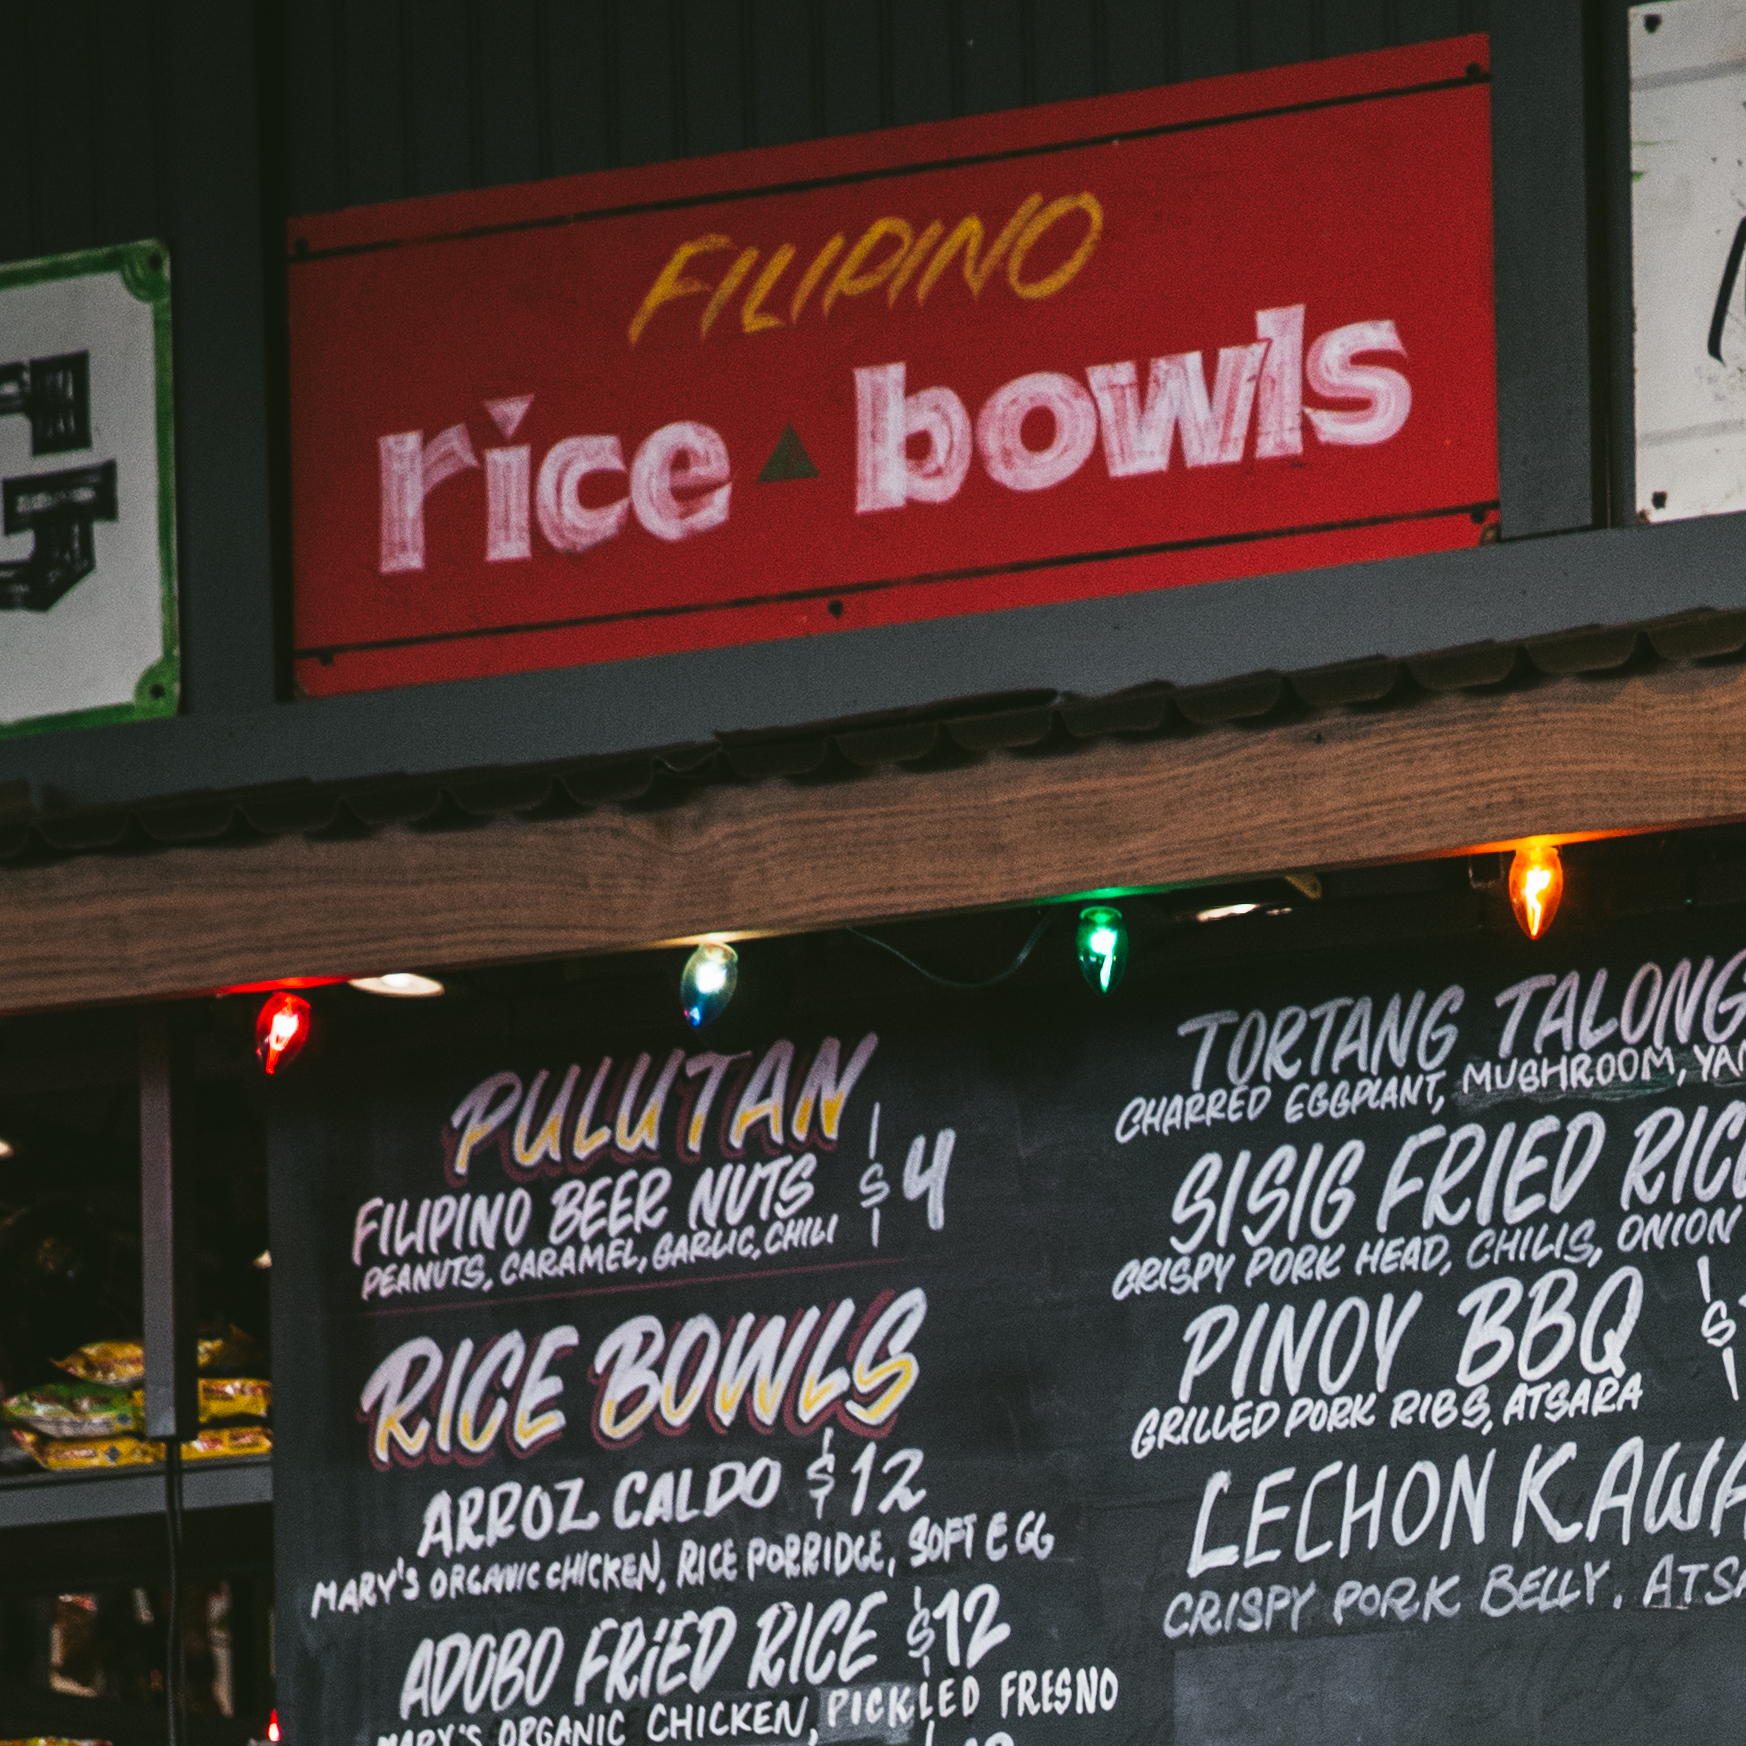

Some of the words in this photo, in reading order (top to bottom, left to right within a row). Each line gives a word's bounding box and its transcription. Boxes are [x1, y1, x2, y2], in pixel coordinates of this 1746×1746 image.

[626, 190, 1105, 348] FILIPINO
[378, 392, 734, 575] rice
[852, 302, 1414, 516] bowls
[1114, 1082, 1270, 1144] CHARRED
[1284, 1068, 1448, 1125] EGGPLANT,
[1461, 1042, 1687, 1095] MUSHROOM,
[1177, 984, 1465, 1092] TORTANG
[443, 1030, 880, 1186] PULUTAN
[351, 1185, 532, 1266] FILIPINO
[549, 1166, 672, 1244] BEER
[686, 1151, 817, 1230] NUTS
[859, 1101, 956, 1247] $4
[1170, 1135, 1363, 1253] SISIG
[1376, 1111, 1606, 1233] FRIED
[361, 1254, 494, 1301] PEANUTS,
[499, 1240, 647, 1287] CARAMEL,
[651, 1230, 760, 1274] GARLIC,
[763, 1212, 838, 1256] CHILI
[1112, 1249, 1237, 1303] CRISPY
[1244, 1240, 1347, 1289] PORK
[1617, 1204, 1744, 1250] ONION
[354, 1323, 581, 1471] RICE
[591, 1285, 928, 1449] BOWLS
[1178, 1291, 1424, 1403] PINOY
[1456, 1265, 1644, 1389] BBQ
[1131, 1400, 1280, 1459] GRILLED
[1285, 1391, 1376, 1437] PORK
[1502, 1371, 1645, 1426] ATSARA
[417, 1479, 598, 1558] ARROZ
[612, 1455, 781, 1530] CALDO
[1185, 1449, 1498, 1579] LECHON
[312, 1558, 421, 1619] MARY'S
[430, 1554, 540, 1599] ORGANIC
[677, 1540, 739, 1583] RICE
[747, 1528, 895, 1579] PORRIDGE,
[909, 1514, 978, 1567] SOFT
[1162, 1586, 1317, 1640] CRISPY
[1334, 1577, 1461, 1628] PORK
[398, 1624, 565, 1720] ADOBO
[747, 1590, 888, 1684] RICE
[646, 1696, 819, 1746] CHICKEN,
[826, 1684, 979, 1728] PICKLED
[999, 1666, 1119, 1718] FRESNO
